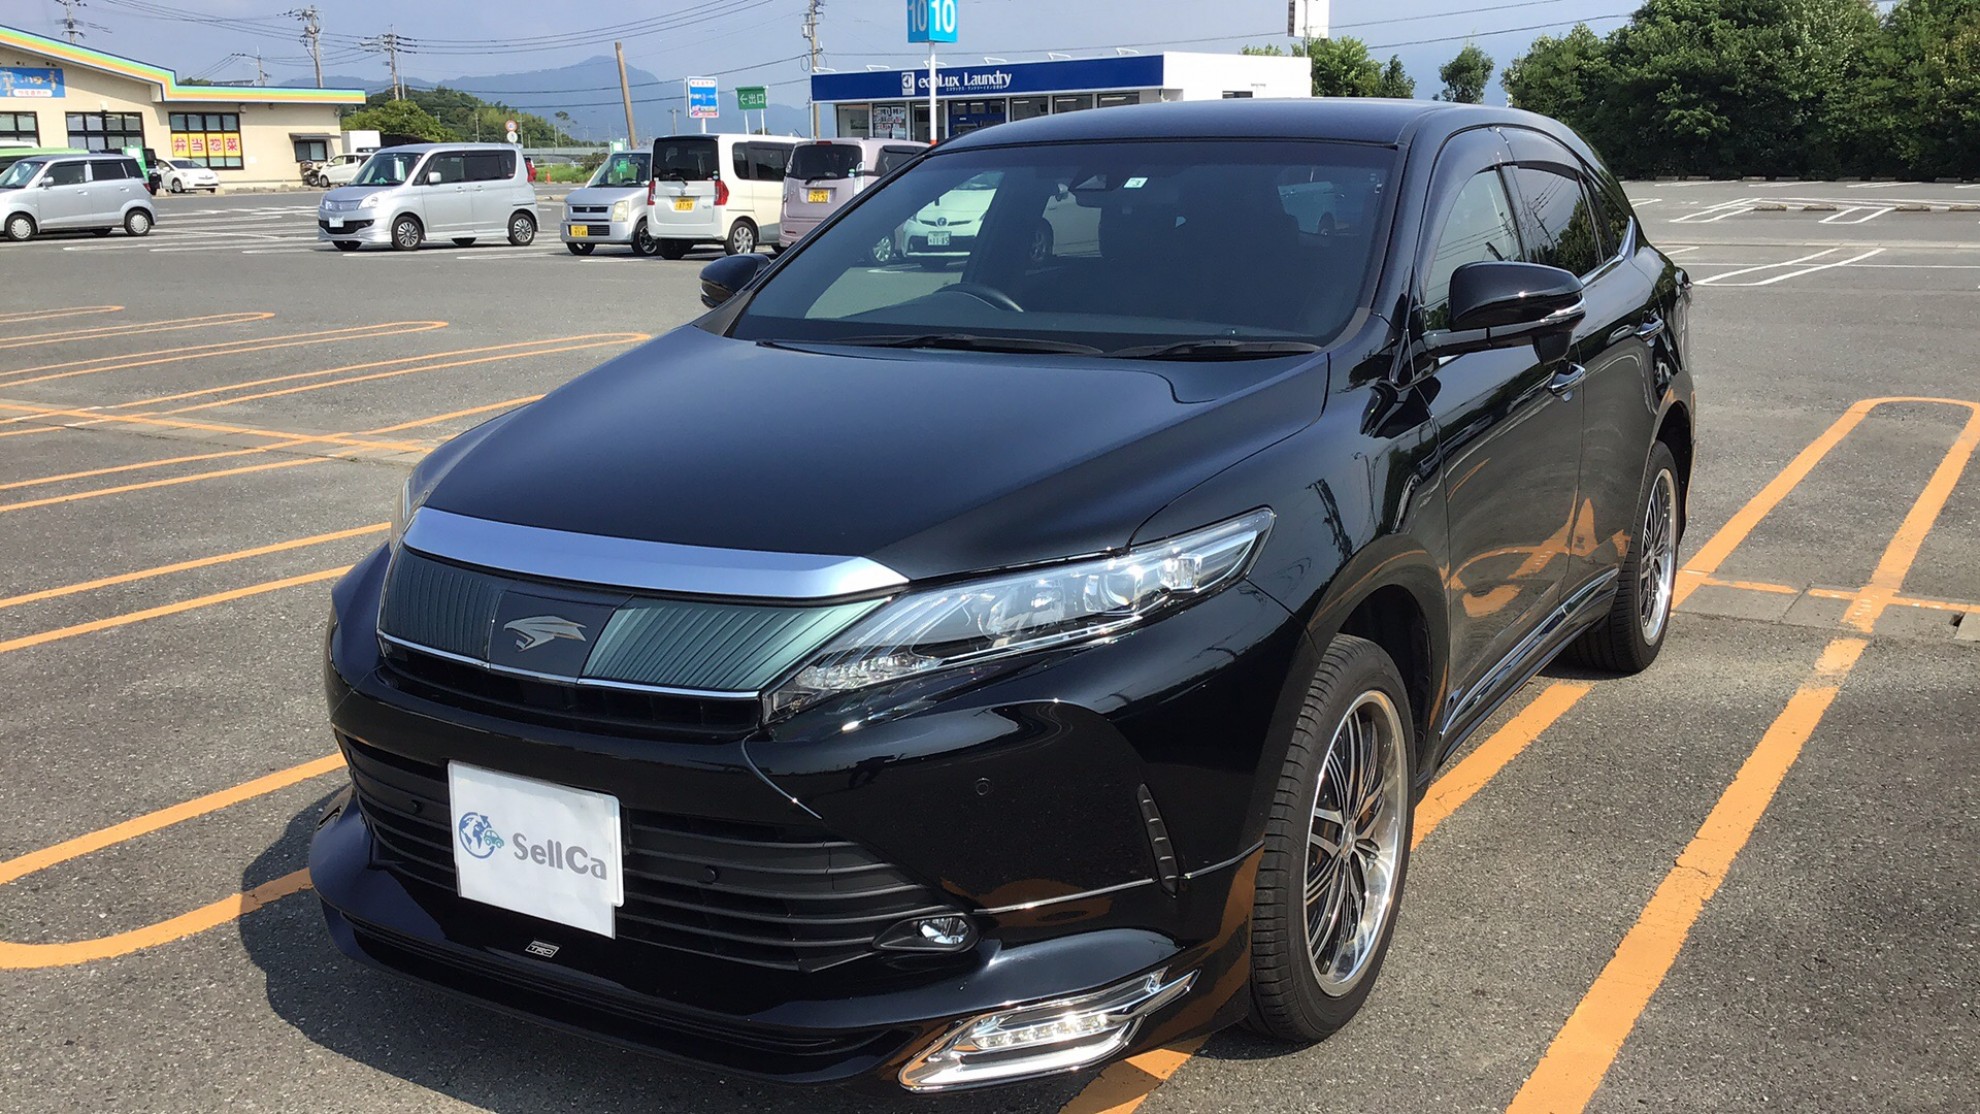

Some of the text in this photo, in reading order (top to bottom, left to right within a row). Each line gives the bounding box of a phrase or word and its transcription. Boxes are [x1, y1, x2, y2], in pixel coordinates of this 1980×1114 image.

[908, 0, 928, 33] 10
[931, 0, 956, 34] 10
[964, 70, 1012, 88] Laundry
[748, 93, 765, 105] 出口
[512, 832, 608, 881] SellCa
